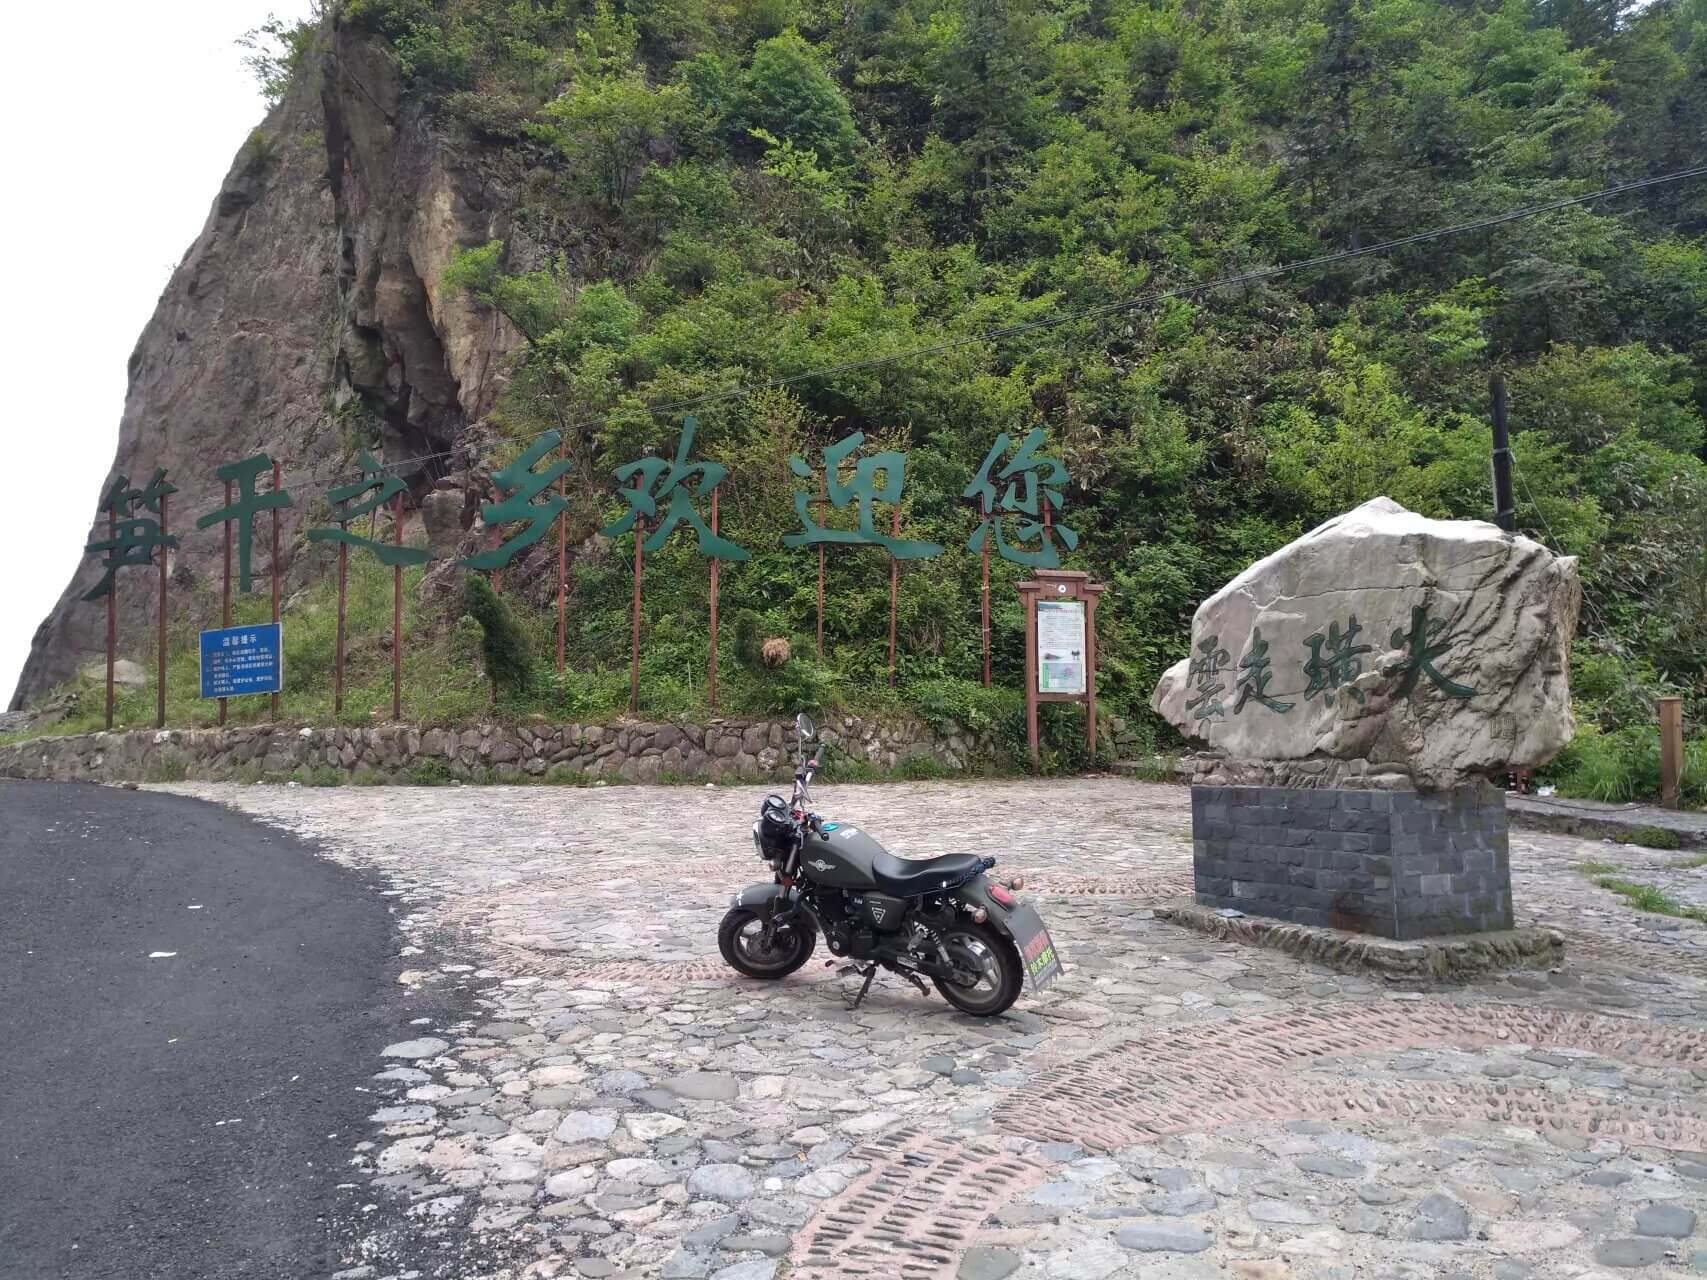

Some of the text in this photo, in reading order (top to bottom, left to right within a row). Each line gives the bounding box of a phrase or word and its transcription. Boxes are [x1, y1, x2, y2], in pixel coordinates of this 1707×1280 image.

[81, 416, 1079, 600] 笋干之乡欢迎您
